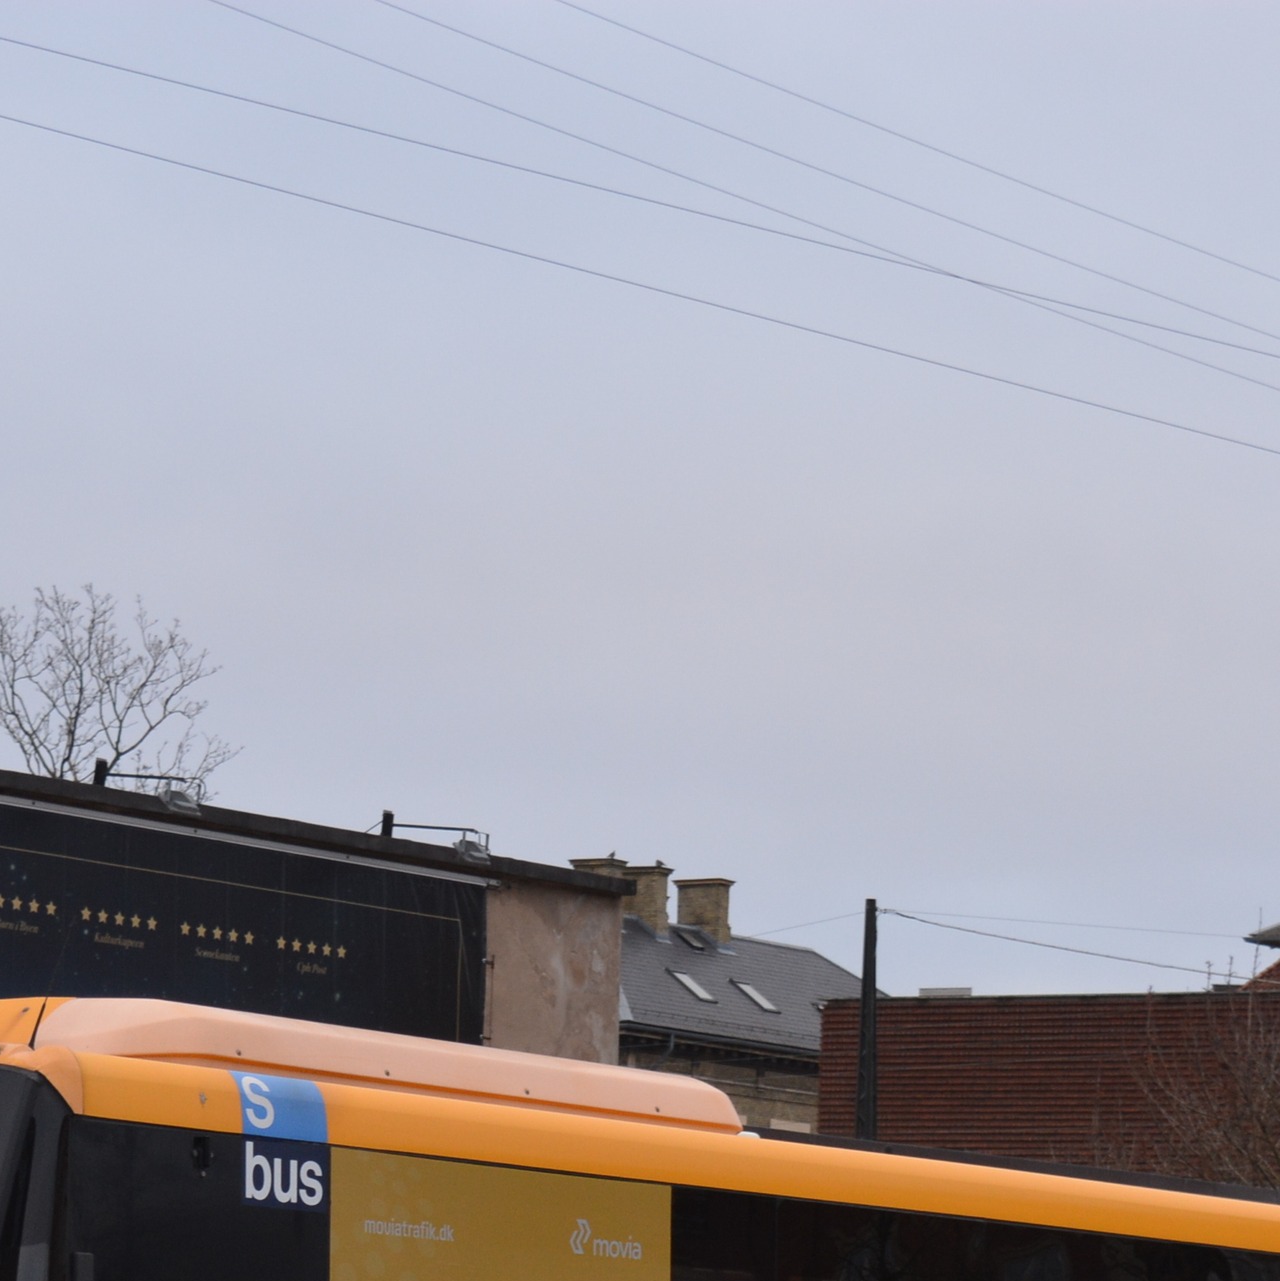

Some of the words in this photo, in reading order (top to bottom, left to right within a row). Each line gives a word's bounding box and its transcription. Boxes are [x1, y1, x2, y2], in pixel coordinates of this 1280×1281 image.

[241, 1076, 275, 1129] S
[245, 1141, 323, 1206] bus
[364, 1218, 455, 1242] moviatrafik.dk
[593, 1238, 642, 1260] movia
